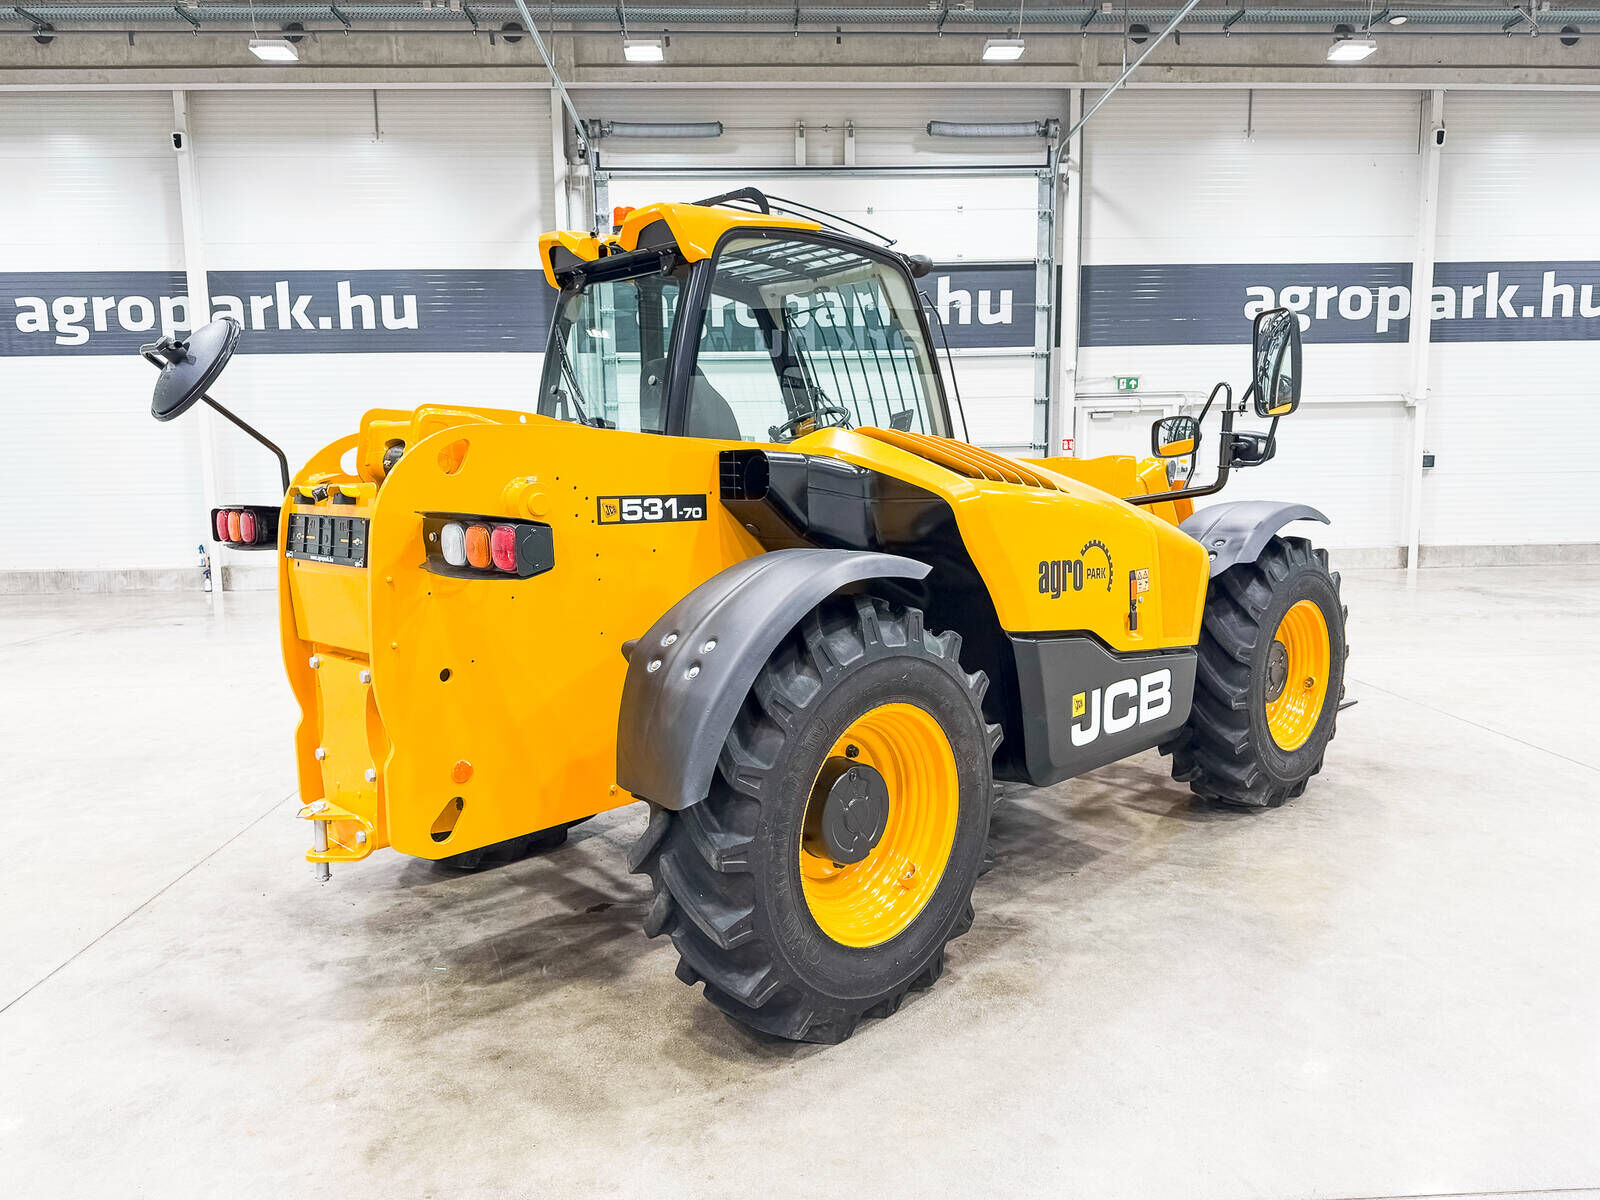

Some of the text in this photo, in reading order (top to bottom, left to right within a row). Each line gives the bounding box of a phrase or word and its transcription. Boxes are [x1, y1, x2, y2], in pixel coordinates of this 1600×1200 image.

[14, 280, 419, 345] agropark.hu
[1243, 271, 1600, 333] agropark.hu
[621, 497, 703, 521] 531-70
[1038, 559, 1106, 599] agro PARK
[1071, 668, 1172, 747] JCB
